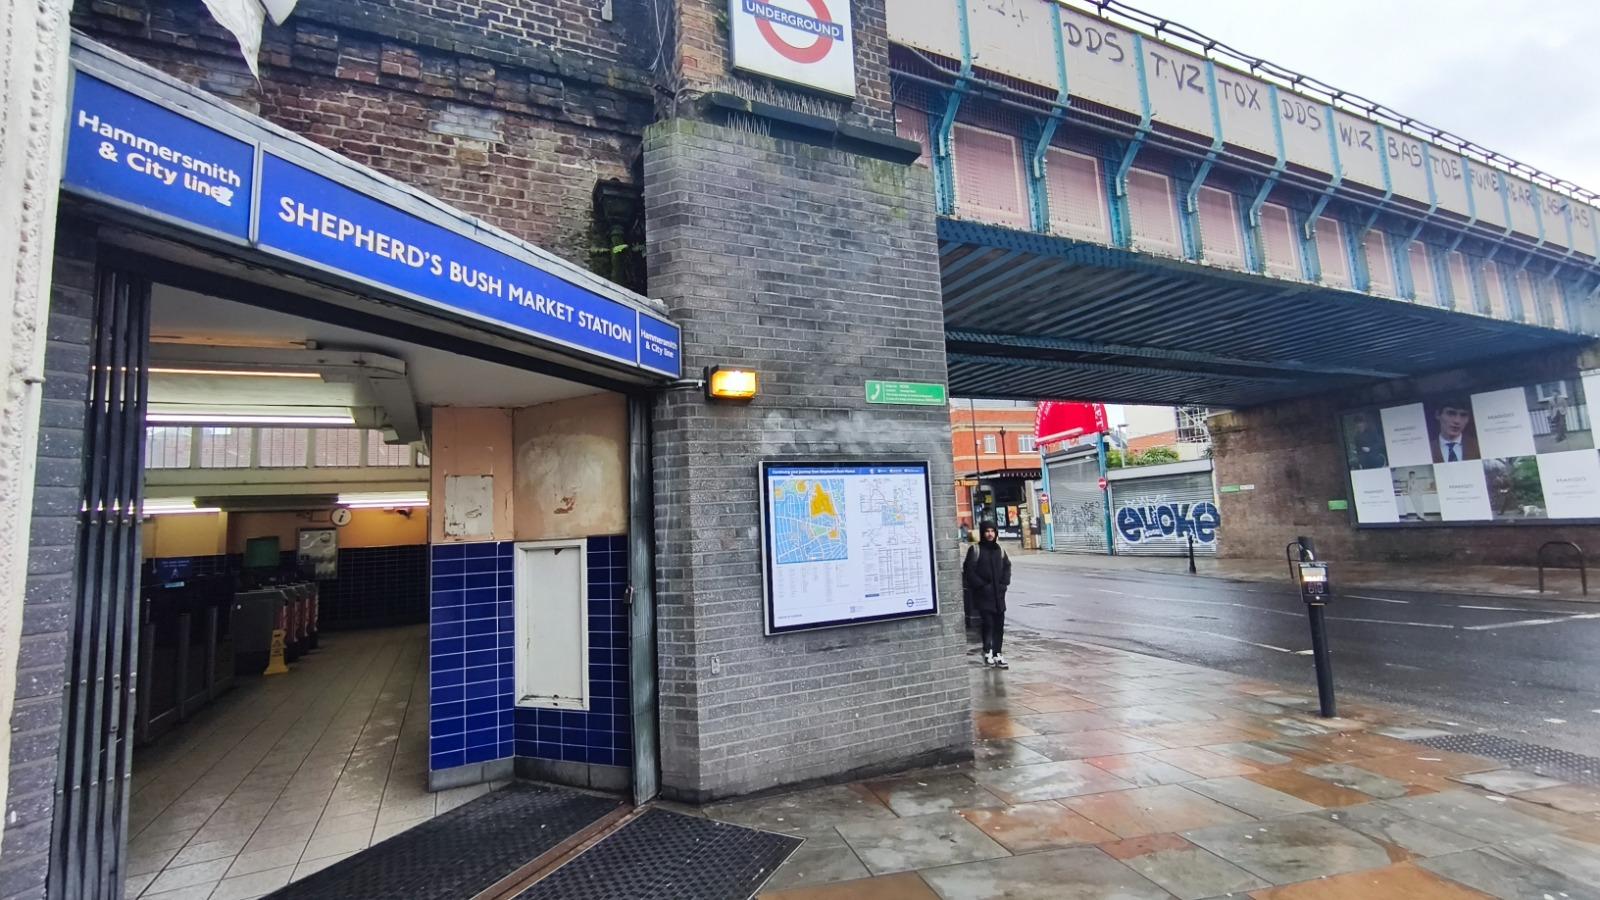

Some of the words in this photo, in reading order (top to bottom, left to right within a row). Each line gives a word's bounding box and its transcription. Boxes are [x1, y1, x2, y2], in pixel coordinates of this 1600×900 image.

[746, 0, 840, 37] UNDERGROUND
[1063, 22, 1124, 63] DDS
[1218, 78, 1262, 111] TOX
[1281, 99, 1321, 131] DDS
[78, 109, 241, 188] Hammersmith
[98, 141, 119, 163] &
[126, 152, 178, 186] City
[1386, 136, 1423, 167] BAS
[1428, 154, 1462, 181] TOE
[278, 196, 443, 277] SHEPHERD'S
[450, 261, 502, 298] BUSH
[508, 283, 574, 323] MARKET
[578, 310, 632, 344] STATION
[651, 343, 664, 356] City
